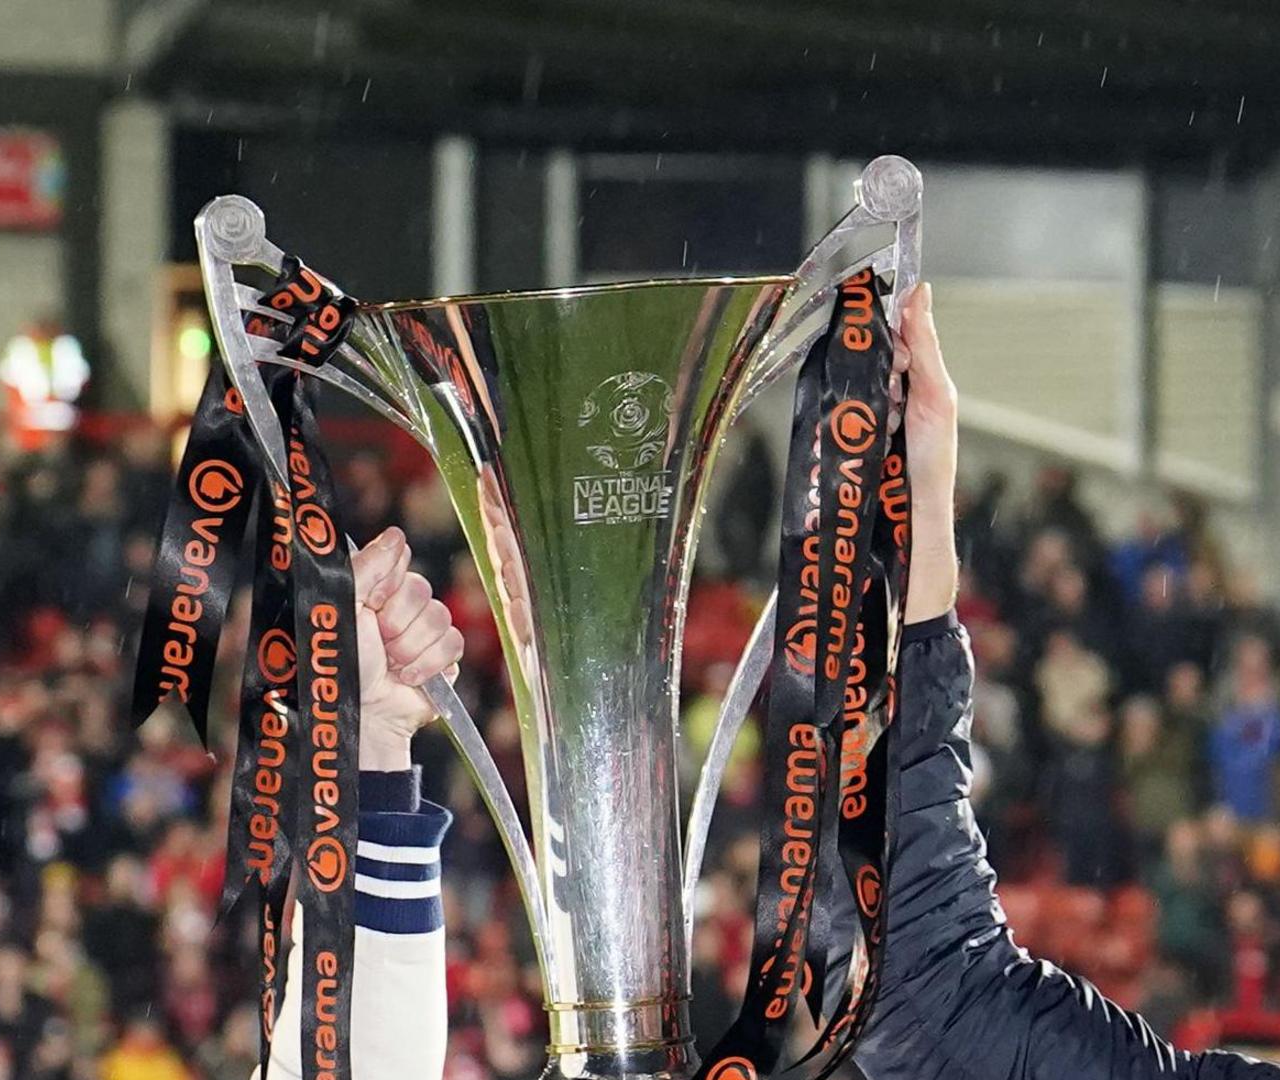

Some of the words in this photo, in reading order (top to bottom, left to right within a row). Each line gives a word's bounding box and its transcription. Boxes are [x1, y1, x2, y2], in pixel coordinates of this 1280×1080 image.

[574, 475, 673, 498] NATIONAL
[574, 491, 670, 520] LEAGUE
[832, 458, 864, 684] vanarama
[310, 602, 340, 833] vanarama
